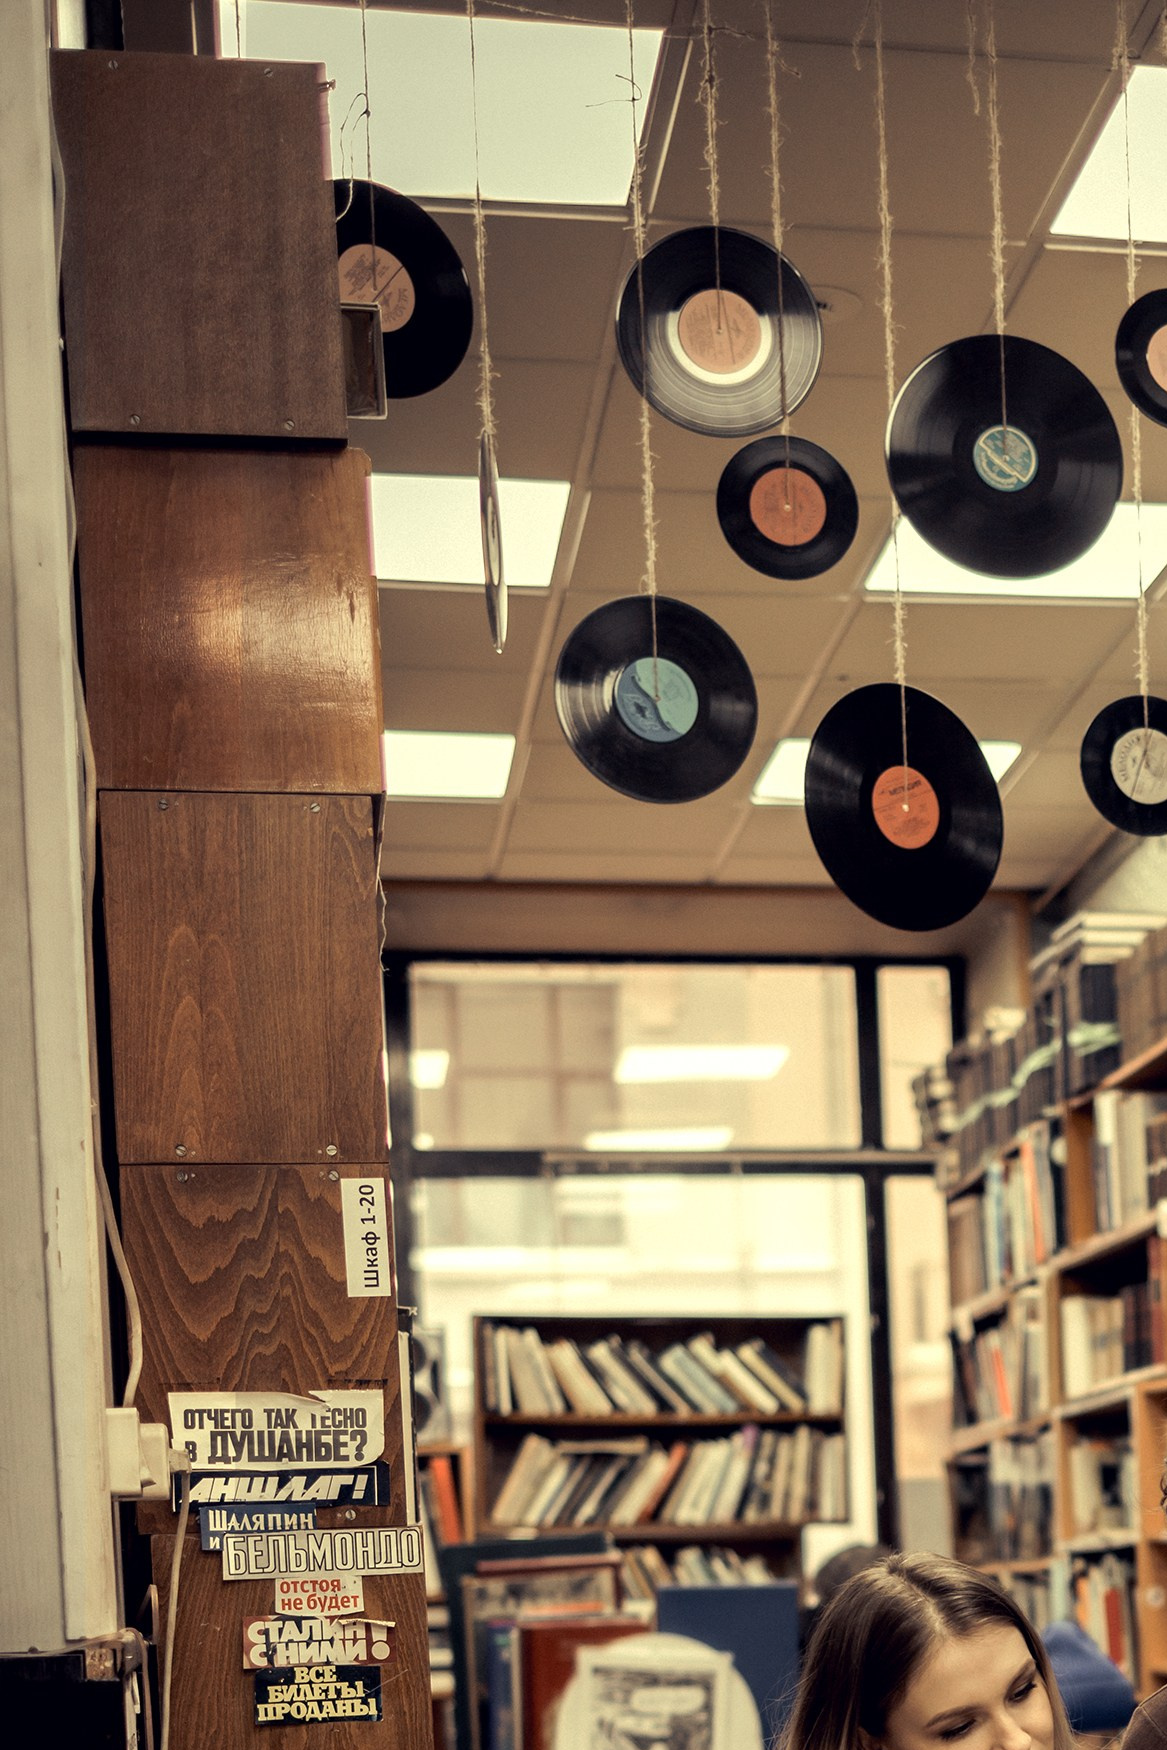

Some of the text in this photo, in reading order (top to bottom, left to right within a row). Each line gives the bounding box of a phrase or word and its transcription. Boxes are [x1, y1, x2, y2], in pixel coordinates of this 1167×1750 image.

[358, 1184, 381, 1288] Шкаф 1-20
[183, 1408, 253, 1430] ОТЧЕГО
[263, 1408, 297, 1430] ТАК
[207, 1430, 368, 1465] ДУШАНБЕ?
[179, 1474, 370, 1503] АНШЛАГ!
[208, 1509, 317, 1532] ШАЛЯПИН
[209, 1528, 422, 1576] и БЕЛЬМОНДО
[279, 1579, 342, 1594] отстоя
[281, 1594, 360, 1617] не будет
[294, 1665, 338, 1684] ВСЕ
[267, 1681, 365, 1704] БИЛЕТЫ
[257, 1698, 379, 1721] ПРОДАНЫ
